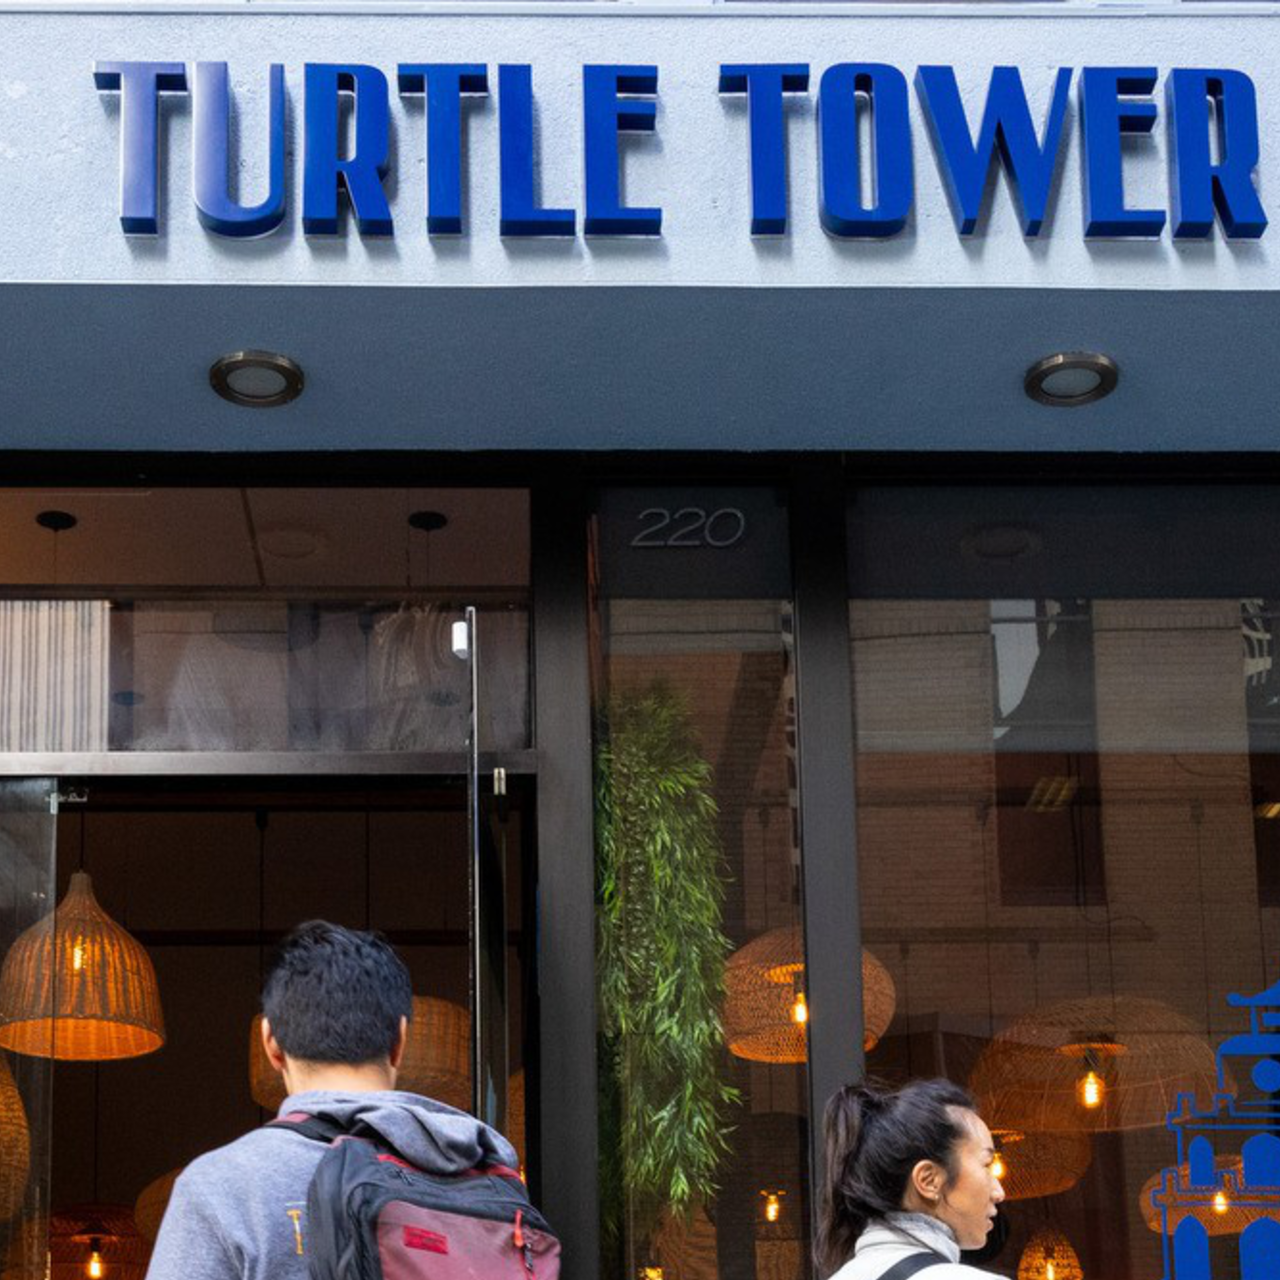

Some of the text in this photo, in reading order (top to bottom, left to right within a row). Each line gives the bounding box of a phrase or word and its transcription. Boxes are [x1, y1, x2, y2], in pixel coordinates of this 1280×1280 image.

[93, 60, 1268, 241] TURTLE TOWER
[630, 507, 745, 546] 220
